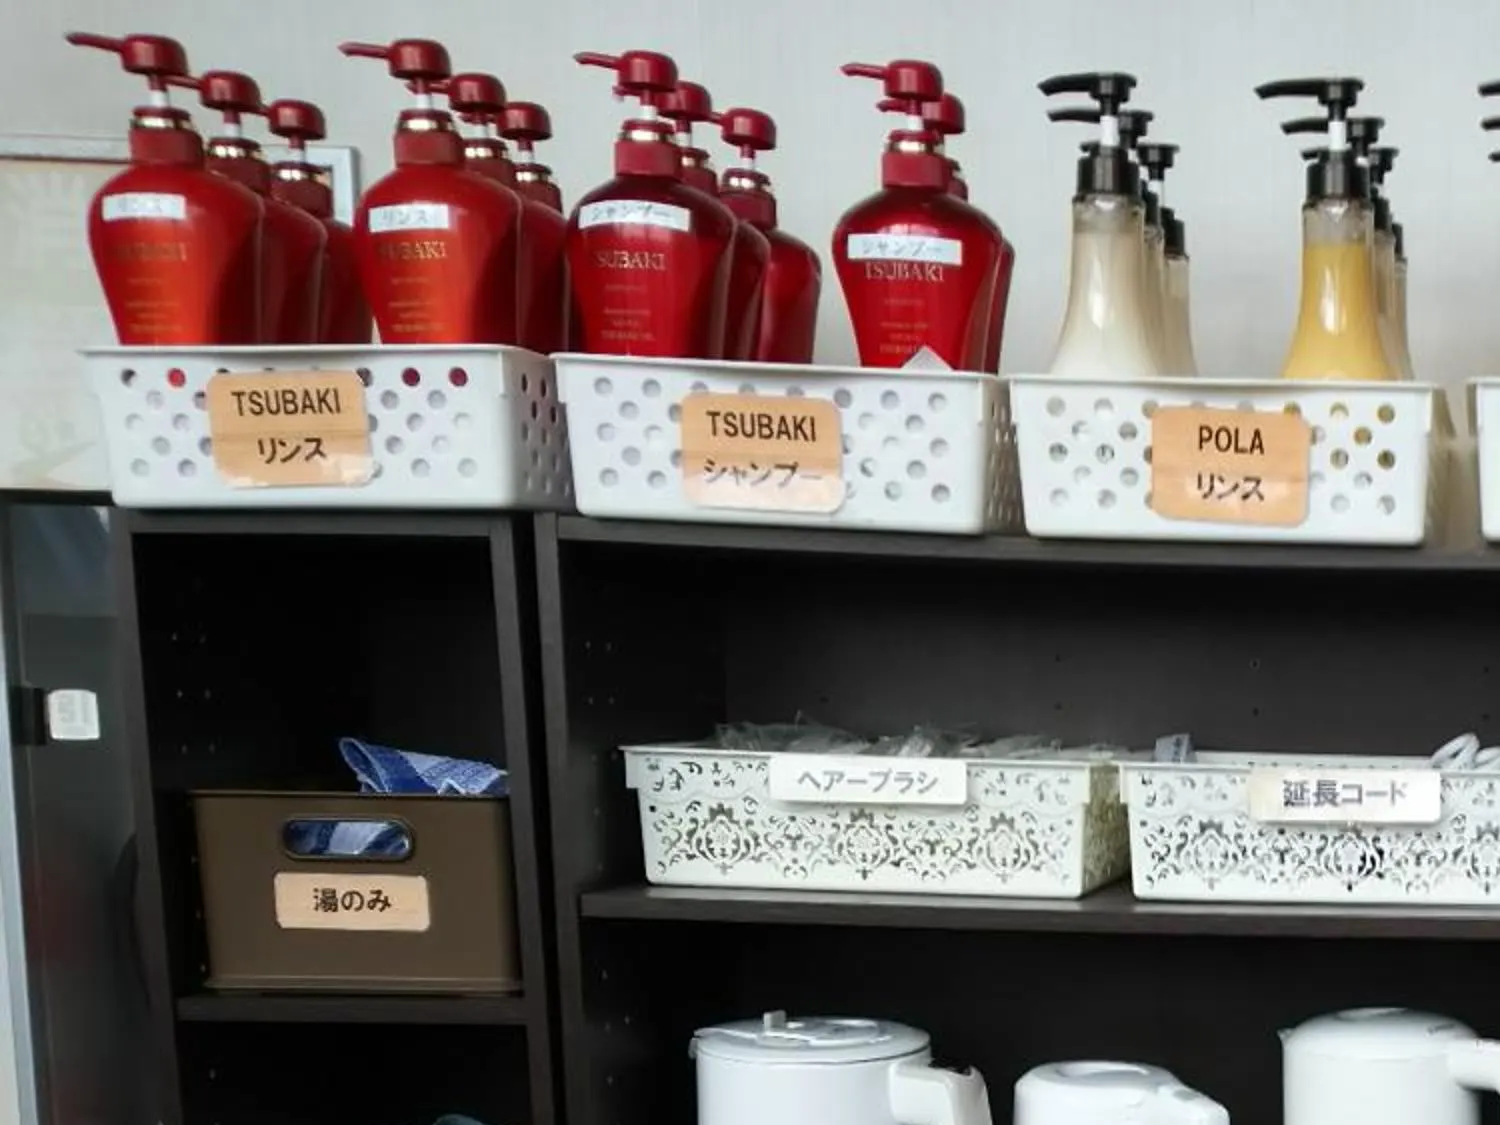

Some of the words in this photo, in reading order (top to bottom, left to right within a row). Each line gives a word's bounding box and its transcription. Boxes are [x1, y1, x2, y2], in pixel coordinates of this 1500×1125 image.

[864, 260, 945, 282] TSUBAKI
[231, 388, 341, 417] TSUBAKI
[706, 411, 817, 442] TSUBAKI
[1198, 424, 1265, 455] POLA
[257, 437, 327, 464] リンス
[704, 458, 822, 488] シャンプー
[1196, 473, 1265, 502] リンス
[797, 767, 938, 794] ヘアーブラシ
[1282, 779, 1408, 808] 延長コード
[312, 887, 392, 913] 湯のみ
